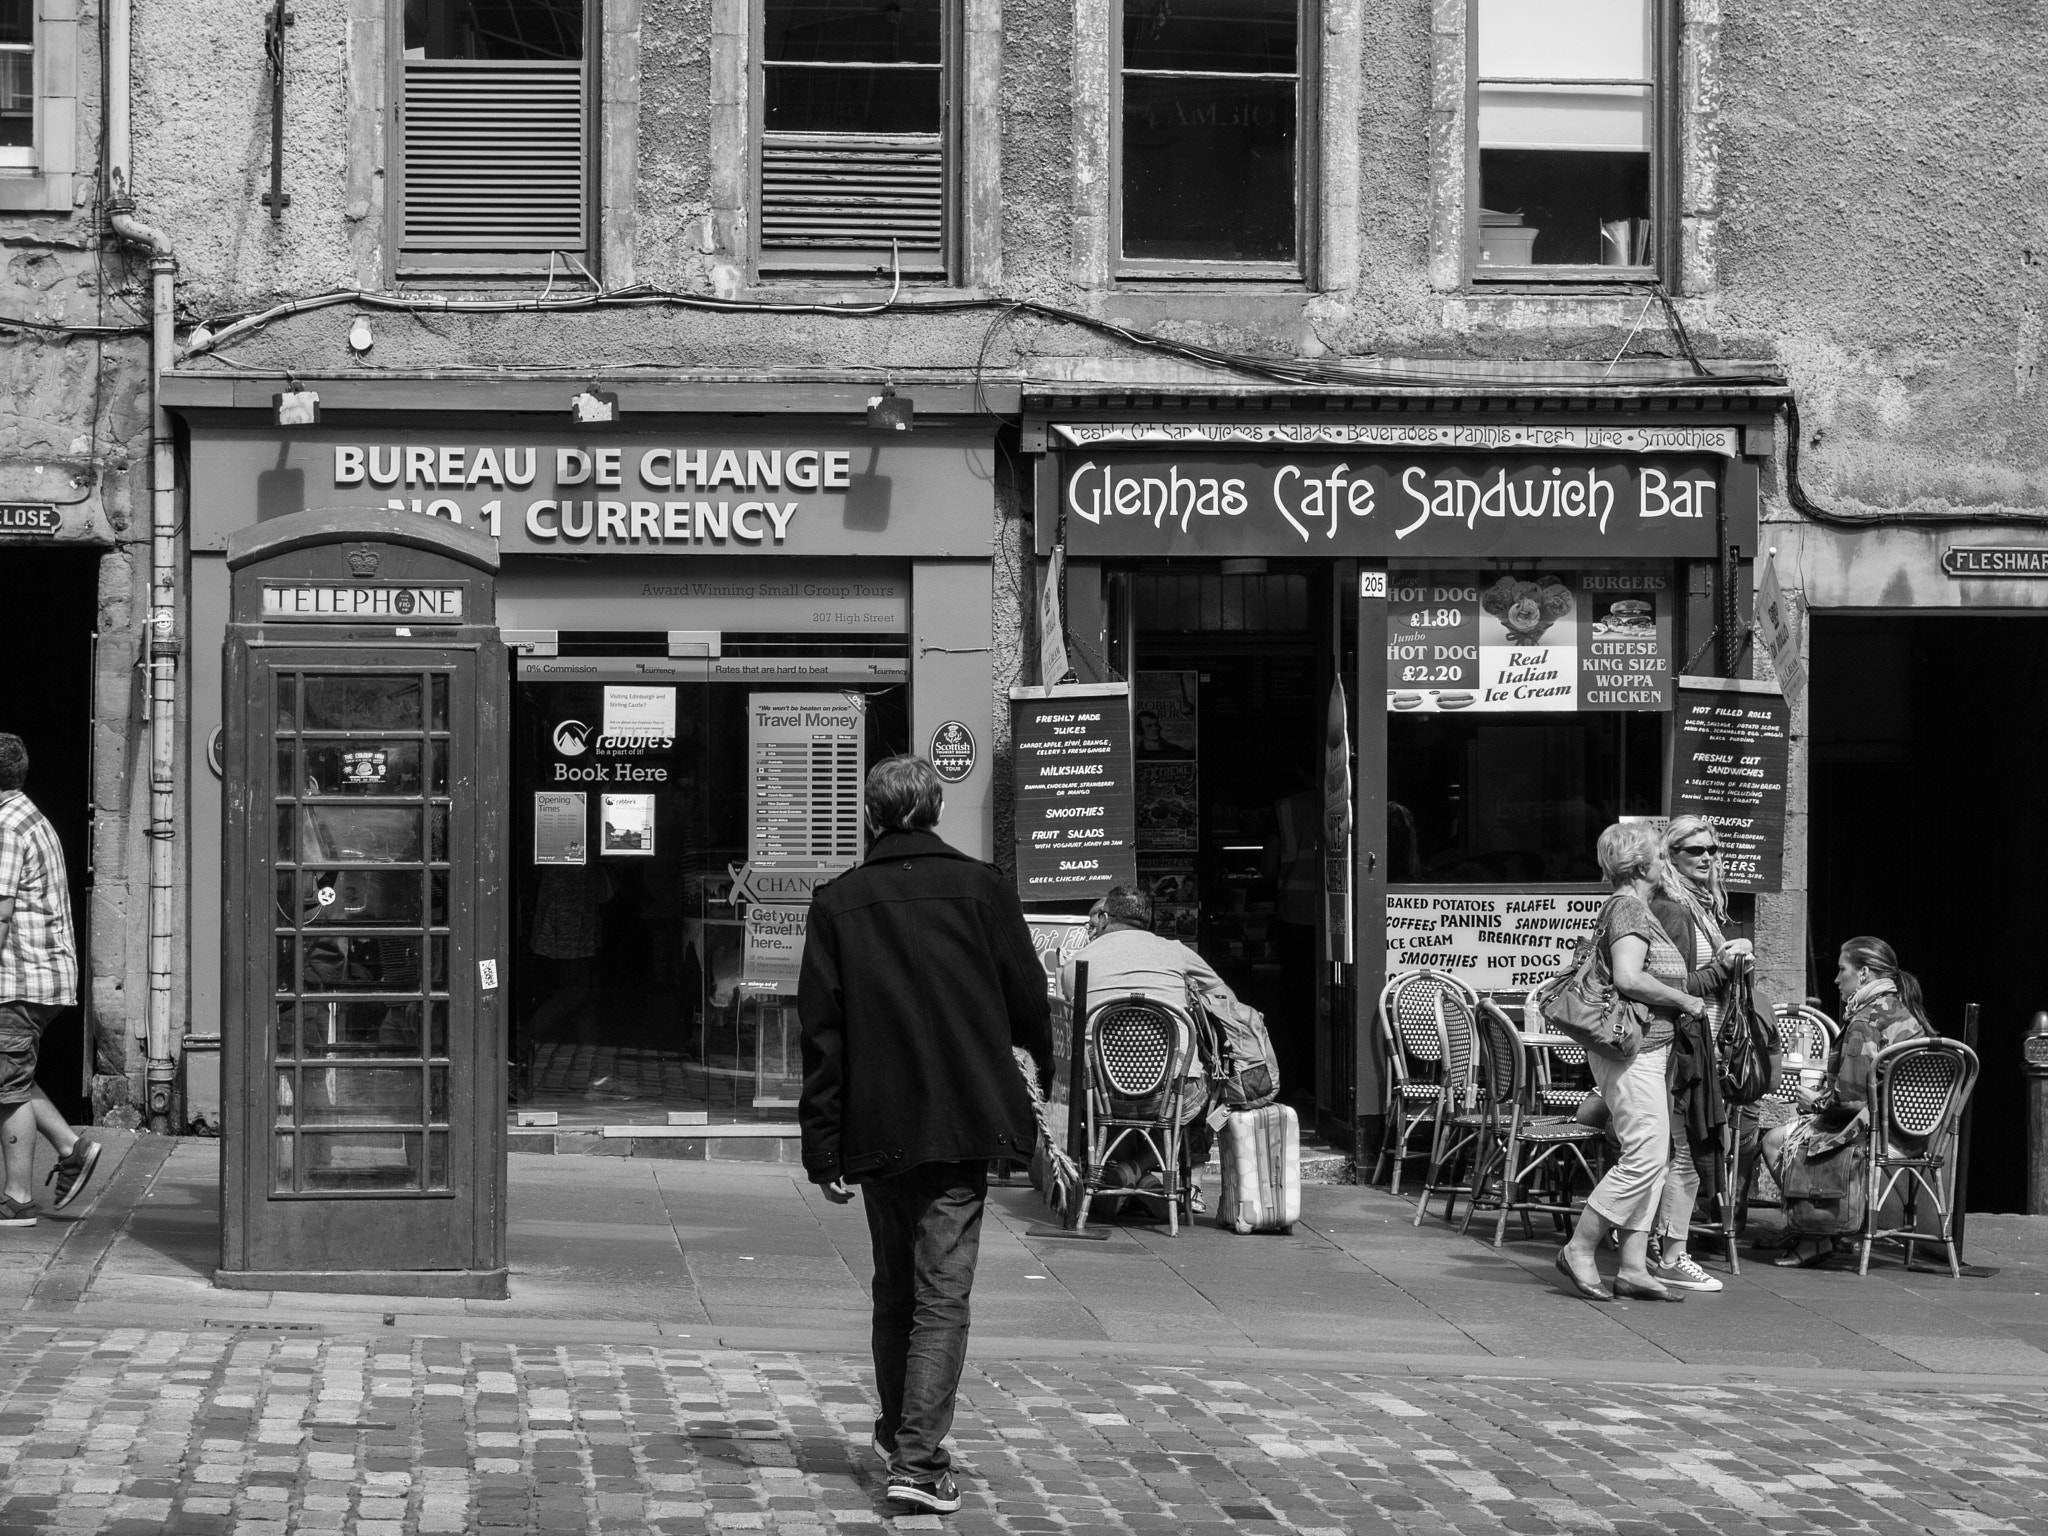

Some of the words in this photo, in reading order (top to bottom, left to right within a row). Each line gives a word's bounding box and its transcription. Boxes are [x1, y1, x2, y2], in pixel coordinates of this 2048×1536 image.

[1278, 424, 1332, 441] Salads
[1348, 425, 1438, 442] Beverages
[1453, 425, 1511, 446] Paninis
[1638, 428, 1726, 451] Smoothies
[335, 446, 537, 486] BUREAU
[556, 448, 622, 485] DE
[639, 448, 851, 488] CHANGE
[1069, 461, 1248, 533] Glenhas
[1273, 463, 1375, 543] Cafe
[1395, 466, 1615, 540] Sandwich
[1639, 467, 1716, 518] Bar
[0, 509, 51, 527] LOSE
[480, 500, 501, 536] 1
[525, 500, 799, 539] CURRENCY
[1364, 576, 1383, 592] 205
[1391, 576, 1420, 587] Large
[1582, 576, 1666, 589] BURGERS
[640, 584, 689, 597] Award
[692, 584, 754, 599] Winning
[758, 584, 800, 597] Small
[803, 584, 850, 599] Group
[853, 584, 894, 597] Tours
[1387, 587, 1427, 602] HOT
[1433, 587, 1478, 602] DOG
[271, 588, 455, 614] TELEPHNE
[812, 613, 831, 622] 207
[834, 612, 860, 624] High
[863, 612, 895, 623] Street
[1410, 608, 1462, 627] £1.80
[1390, 631, 1426, 645] Jumbo
[1387, 645, 1428, 660] HOT
[1433, 645, 1478, 661] DOG
[1590, 642, 1658, 655] CHEESE
[1508, 649, 1549, 667] Real
[1582, 658, 1623, 671] KING
[1628, 658, 1667, 671] SIZE
[526, 665, 541, 673] 0%
[543, 664, 598, 673] Commission
[645, 667, 676, 675] currency
[715, 665, 741, 674] Rates
[742, 665, 760, 674] that
[776, 665, 796, 674] hard
[798, 666, 808, 674] to
[809, 665, 829, 674] beat
[877, 667, 908, 676] currency
[1402, 665, 1462, 682] £2.20
[1497, 666, 1558, 685] Italian
[1595, 674, 1654, 687] WOPPA
[1484, 688, 1509, 703] Ice
[1513, 684, 1572, 700] Cream
[1586, 690, 1662, 703] CHICKEN
[1137, 700, 1184, 711] ROBERT
[1035, 714, 1075, 723] FRESHLY
[1077, 713, 1101, 721] MADE
[1692, 706, 1711, 715] HOT
[1715, 708, 1743, 717] FILLED
[1747, 710, 1772, 720] ROLLS
[755, 713, 801, 727] Travel
[805, 713, 858, 730] Money
[1053, 726, 1087, 735] JUICES
[612, 749, 627, 757] part
[935, 741, 970, 751] Scottish
[1692, 752, 1734, 763] FRESHLY
[1740, 756, 1761, 765] CUT
[553, 762, 610, 781] Book
[614, 763, 668, 781] Here
[1040, 765, 1103, 777] MILKSHAKES
[1706, 765, 1764, 778] SANDWICHES
[538, 796, 571, 805] Opening
[538, 804, 561, 813] Times
[1045, 806, 1105, 819] SMOOTHIES
[1700, 814, 1754, 828] BREAKFAST
[1031, 830, 1060, 840] FRUIT
[1067, 828, 1105, 838] SALADS
[1059, 859, 1099, 870] SALADS
[1387, 897, 1429, 909] BAKED
[1432, 899, 1495, 912] POTATOES
[1506, 899, 1556, 914] FALAFEL
[1567, 900, 1606, 913] SOUP
[751, 908, 777, 922] Get
[751, 922, 792, 936] Travel
[1386, 916, 1437, 931] COFFEES
[1440, 914, 1502, 928] PANINIS
[1515, 918, 1599, 930] SANDWICHES
[1386, 937, 1406, 950] ICE
[1409, 933, 1453, 948] CREAM
[1478, 930, 1552, 948] BREAKFAST
[1398, 951, 1478, 968] SMOOTHIES
[1487, 955, 1516, 968] HOT
[1521, 954, 1561, 967] DOGS
